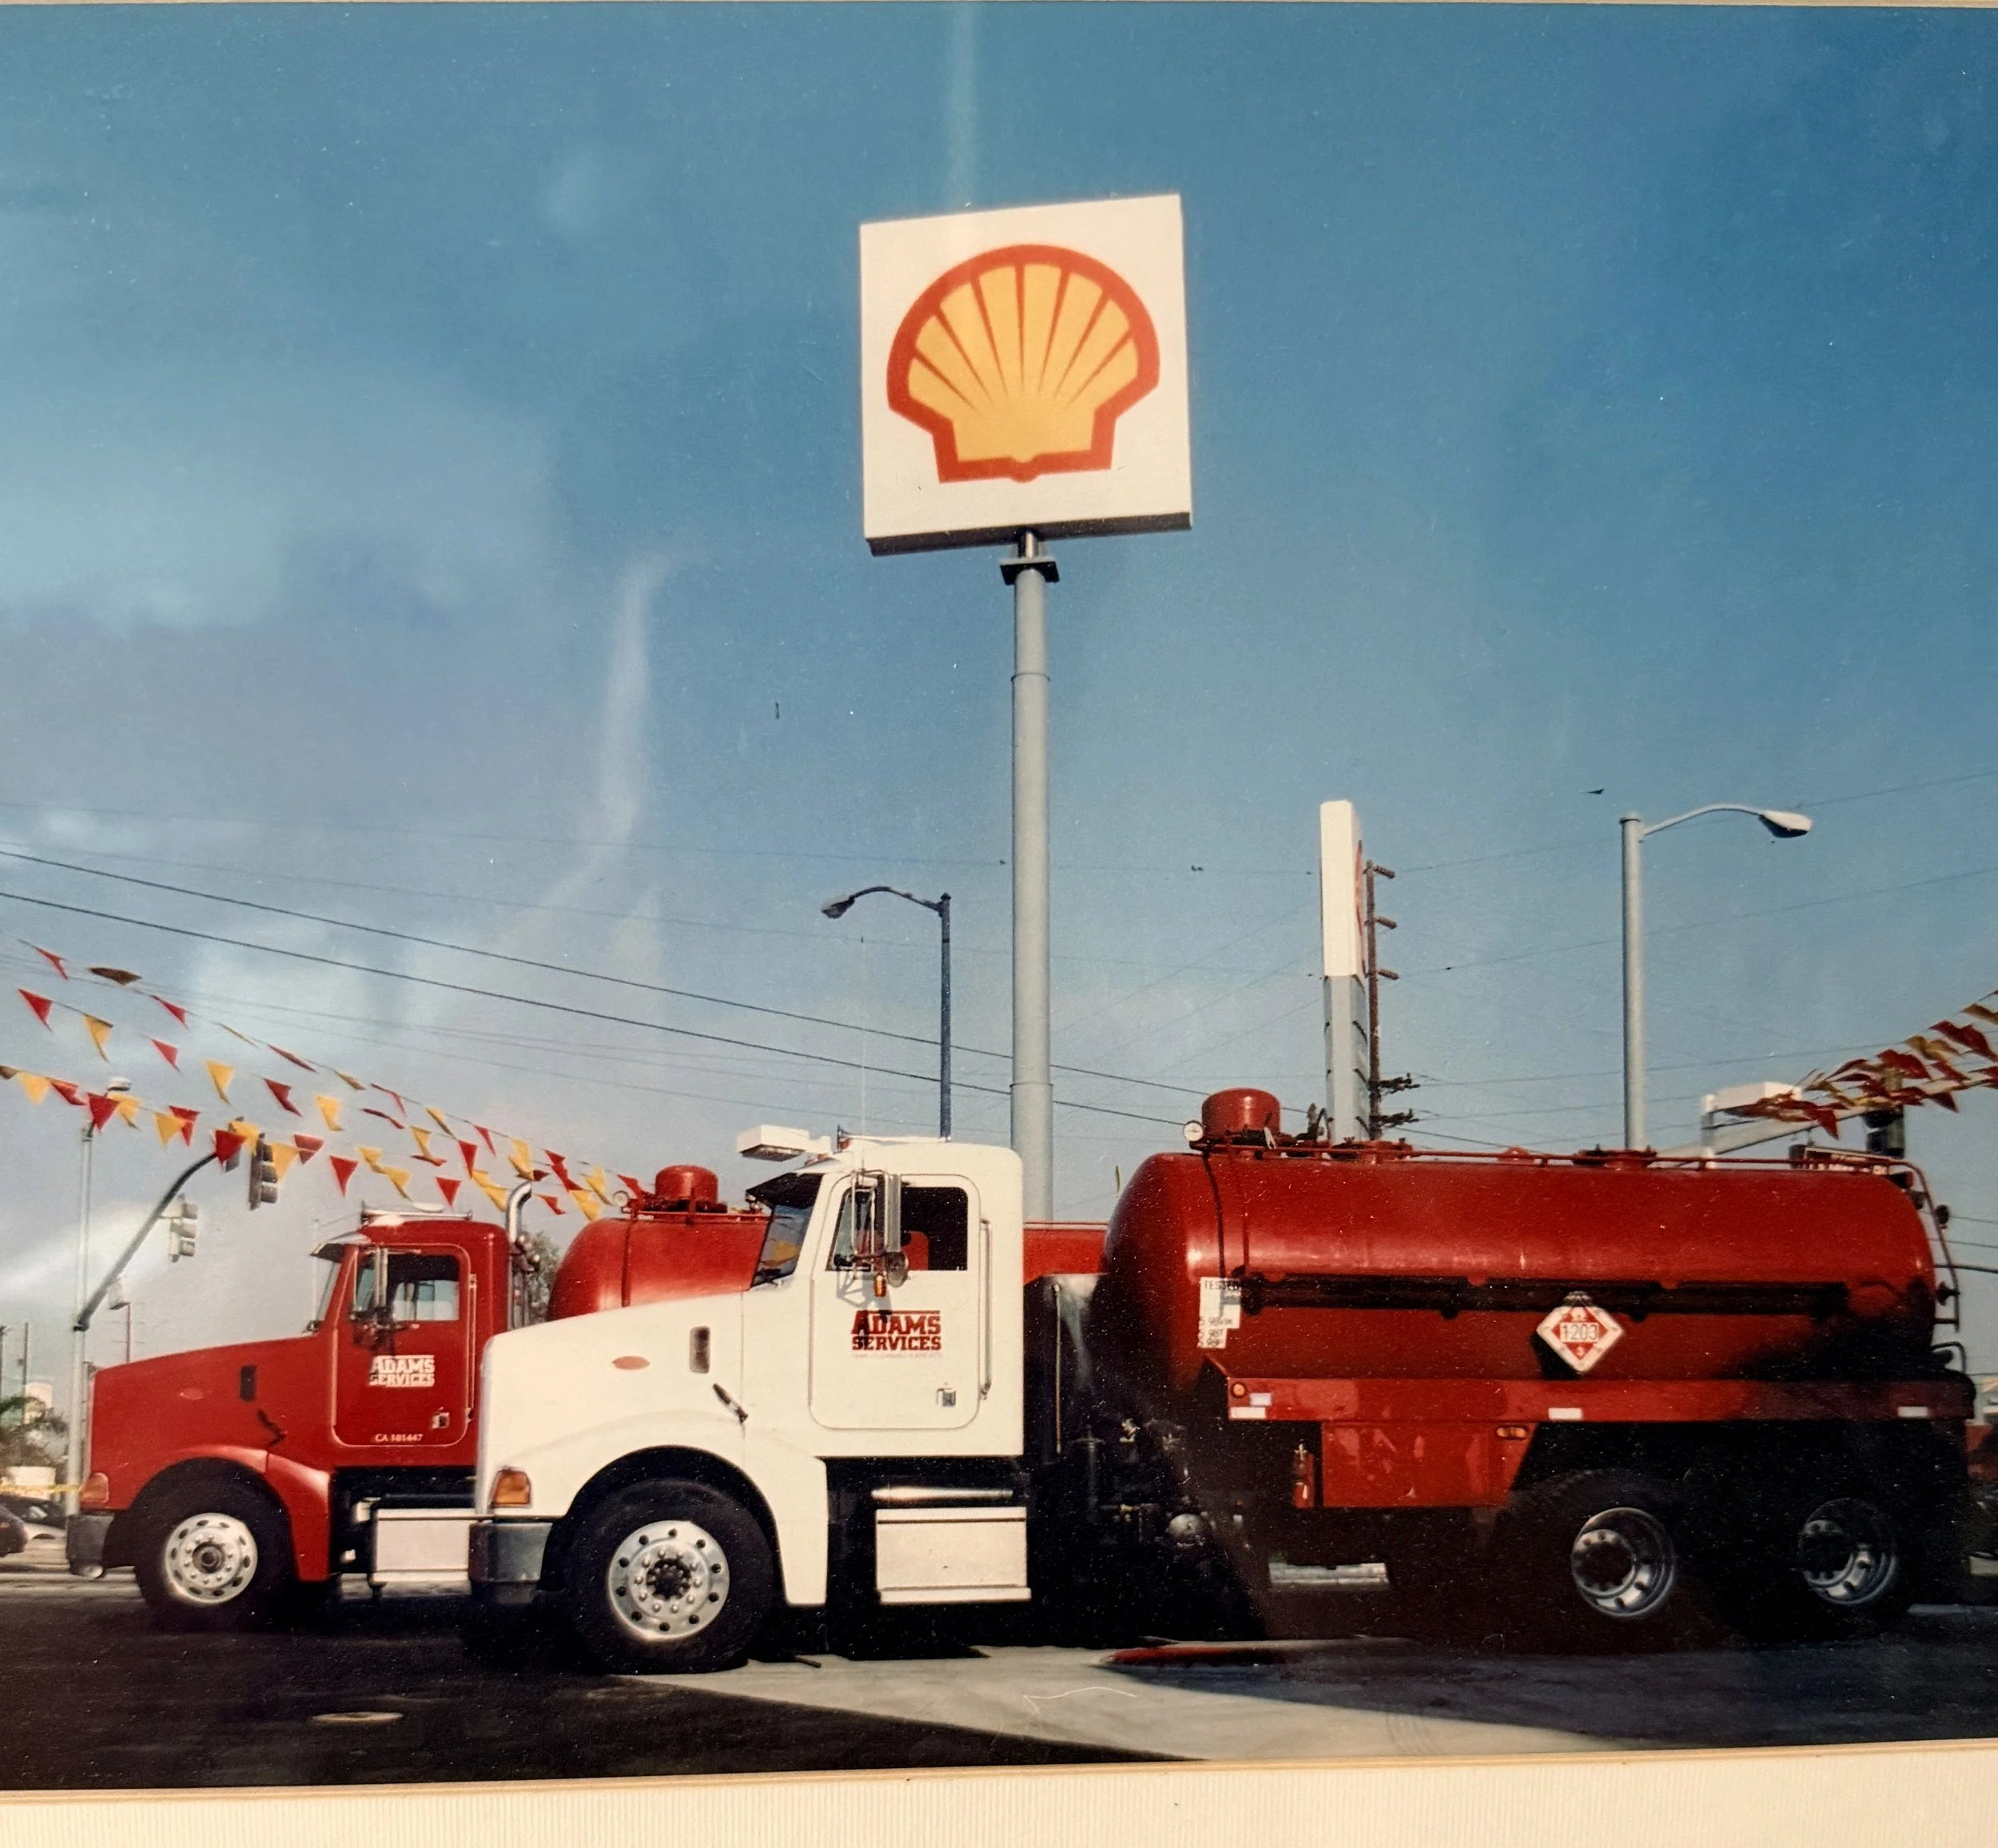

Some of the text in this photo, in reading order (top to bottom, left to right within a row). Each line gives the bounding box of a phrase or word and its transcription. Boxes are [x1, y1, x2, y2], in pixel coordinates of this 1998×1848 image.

[851, 1310, 941, 1334] ADAMS
[1562, 1324, 1598, 1340] 1203
[852, 1336, 941, 1350] SERVICES
[370, 1355, 435, 1373] ADAMS
[368, 1373, 435, 1388] SERVICES
[375, 1433, 388, 1442] CA
